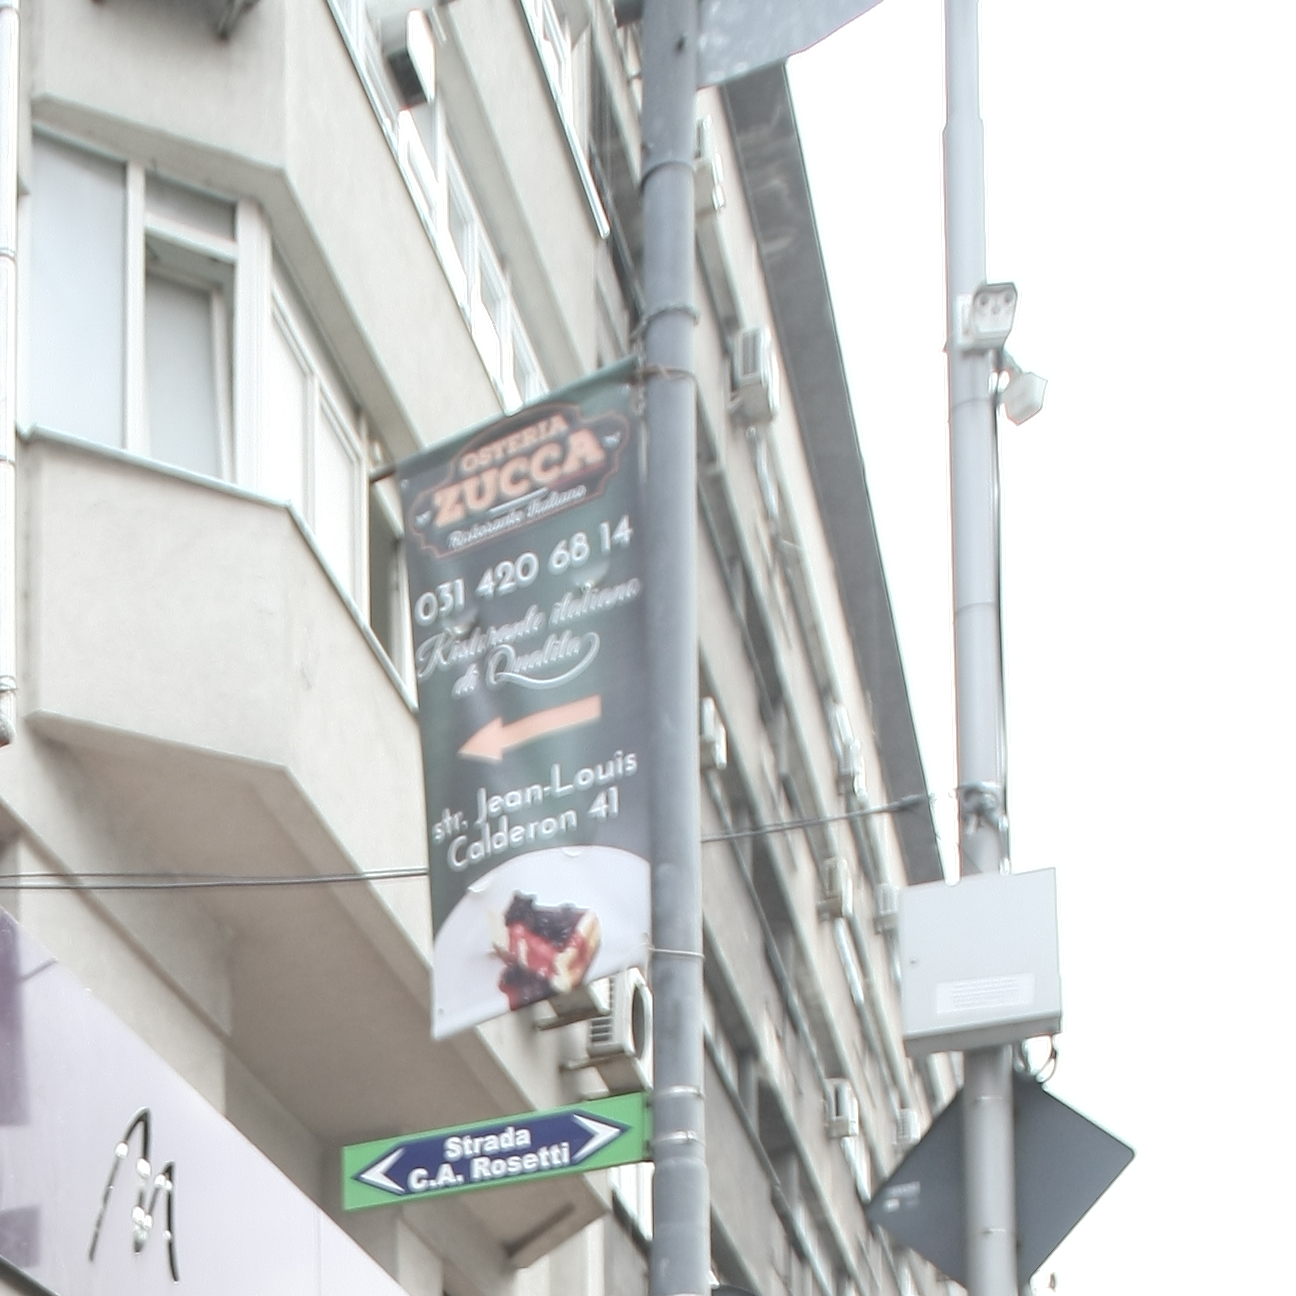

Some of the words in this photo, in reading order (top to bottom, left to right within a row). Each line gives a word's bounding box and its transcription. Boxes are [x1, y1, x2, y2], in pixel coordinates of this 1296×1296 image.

[433, 429, 606, 528] ZUCCA
[460, 413, 569, 473] OSTERIA
[414, 579, 466, 627] 031
[475, 552, 539, 599] 420
[548, 531, 590, 574] 68
[599, 514, 634, 554] 14
[432, 807, 468, 844] str.
[474, 750, 638, 830] Jean-Louis
[447, 809, 577, 872] Calderon
[587, 785, 619, 821] 41
[407, 1163, 465, 1192] C.A.
[470, 1142, 570, 1180] Rosetti
[444, 1126, 531, 1161] Strada
